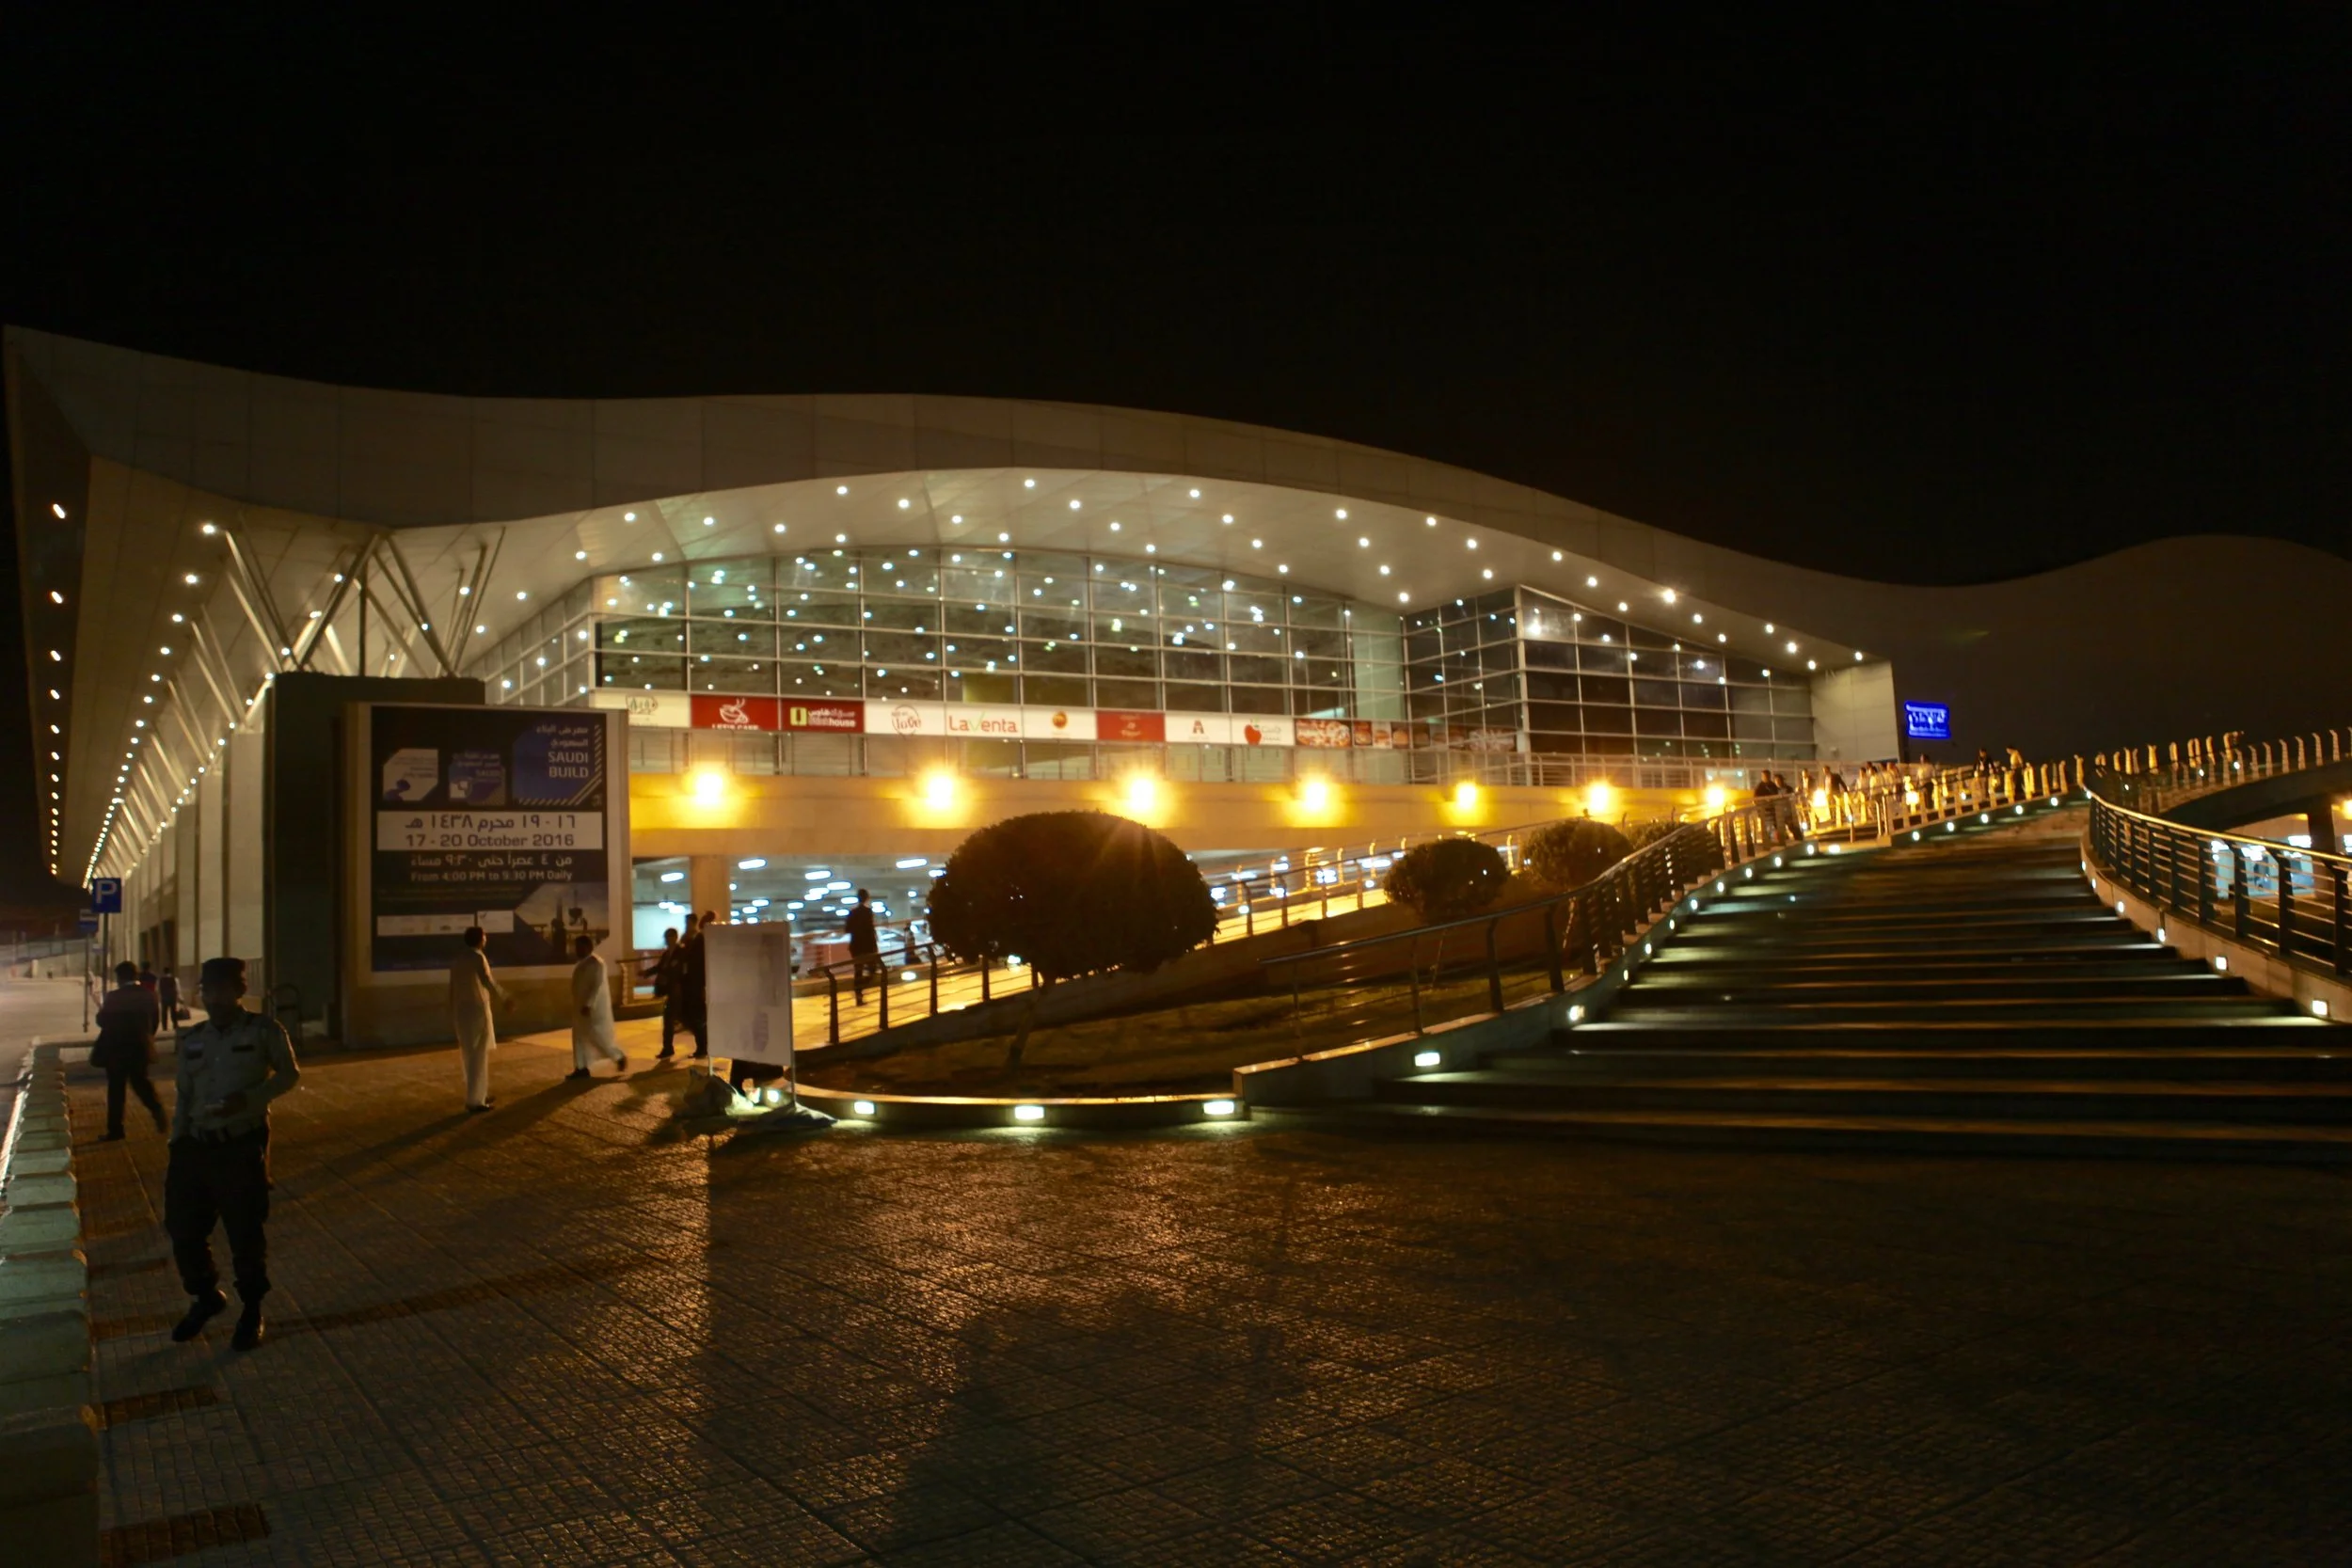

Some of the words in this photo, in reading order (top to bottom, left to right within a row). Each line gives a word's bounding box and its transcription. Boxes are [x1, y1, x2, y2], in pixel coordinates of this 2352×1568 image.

[949, 712, 1018, 733] LaVenta
[548, 752, 589, 764] SAUDI
[548, 767, 589, 779] BUILD
[432, 815, 473, 828] ١٤٣٨
[478, 817, 515, 832] محرم
[405, 834, 426, 847] 17
[440, 834, 463, 847] 20
[468, 833, 528, 847] October
[532, 833, 575, 847] 2016
[555, 855, 573, 867] من
[411, 871, 439, 881] From
[469, 871, 486, 880] PM
[489, 871, 500, 880] to
[529, 870, 545, 879] PM
[548, 869, 573, 881] Daily
[96, 879, 117, 903] P
